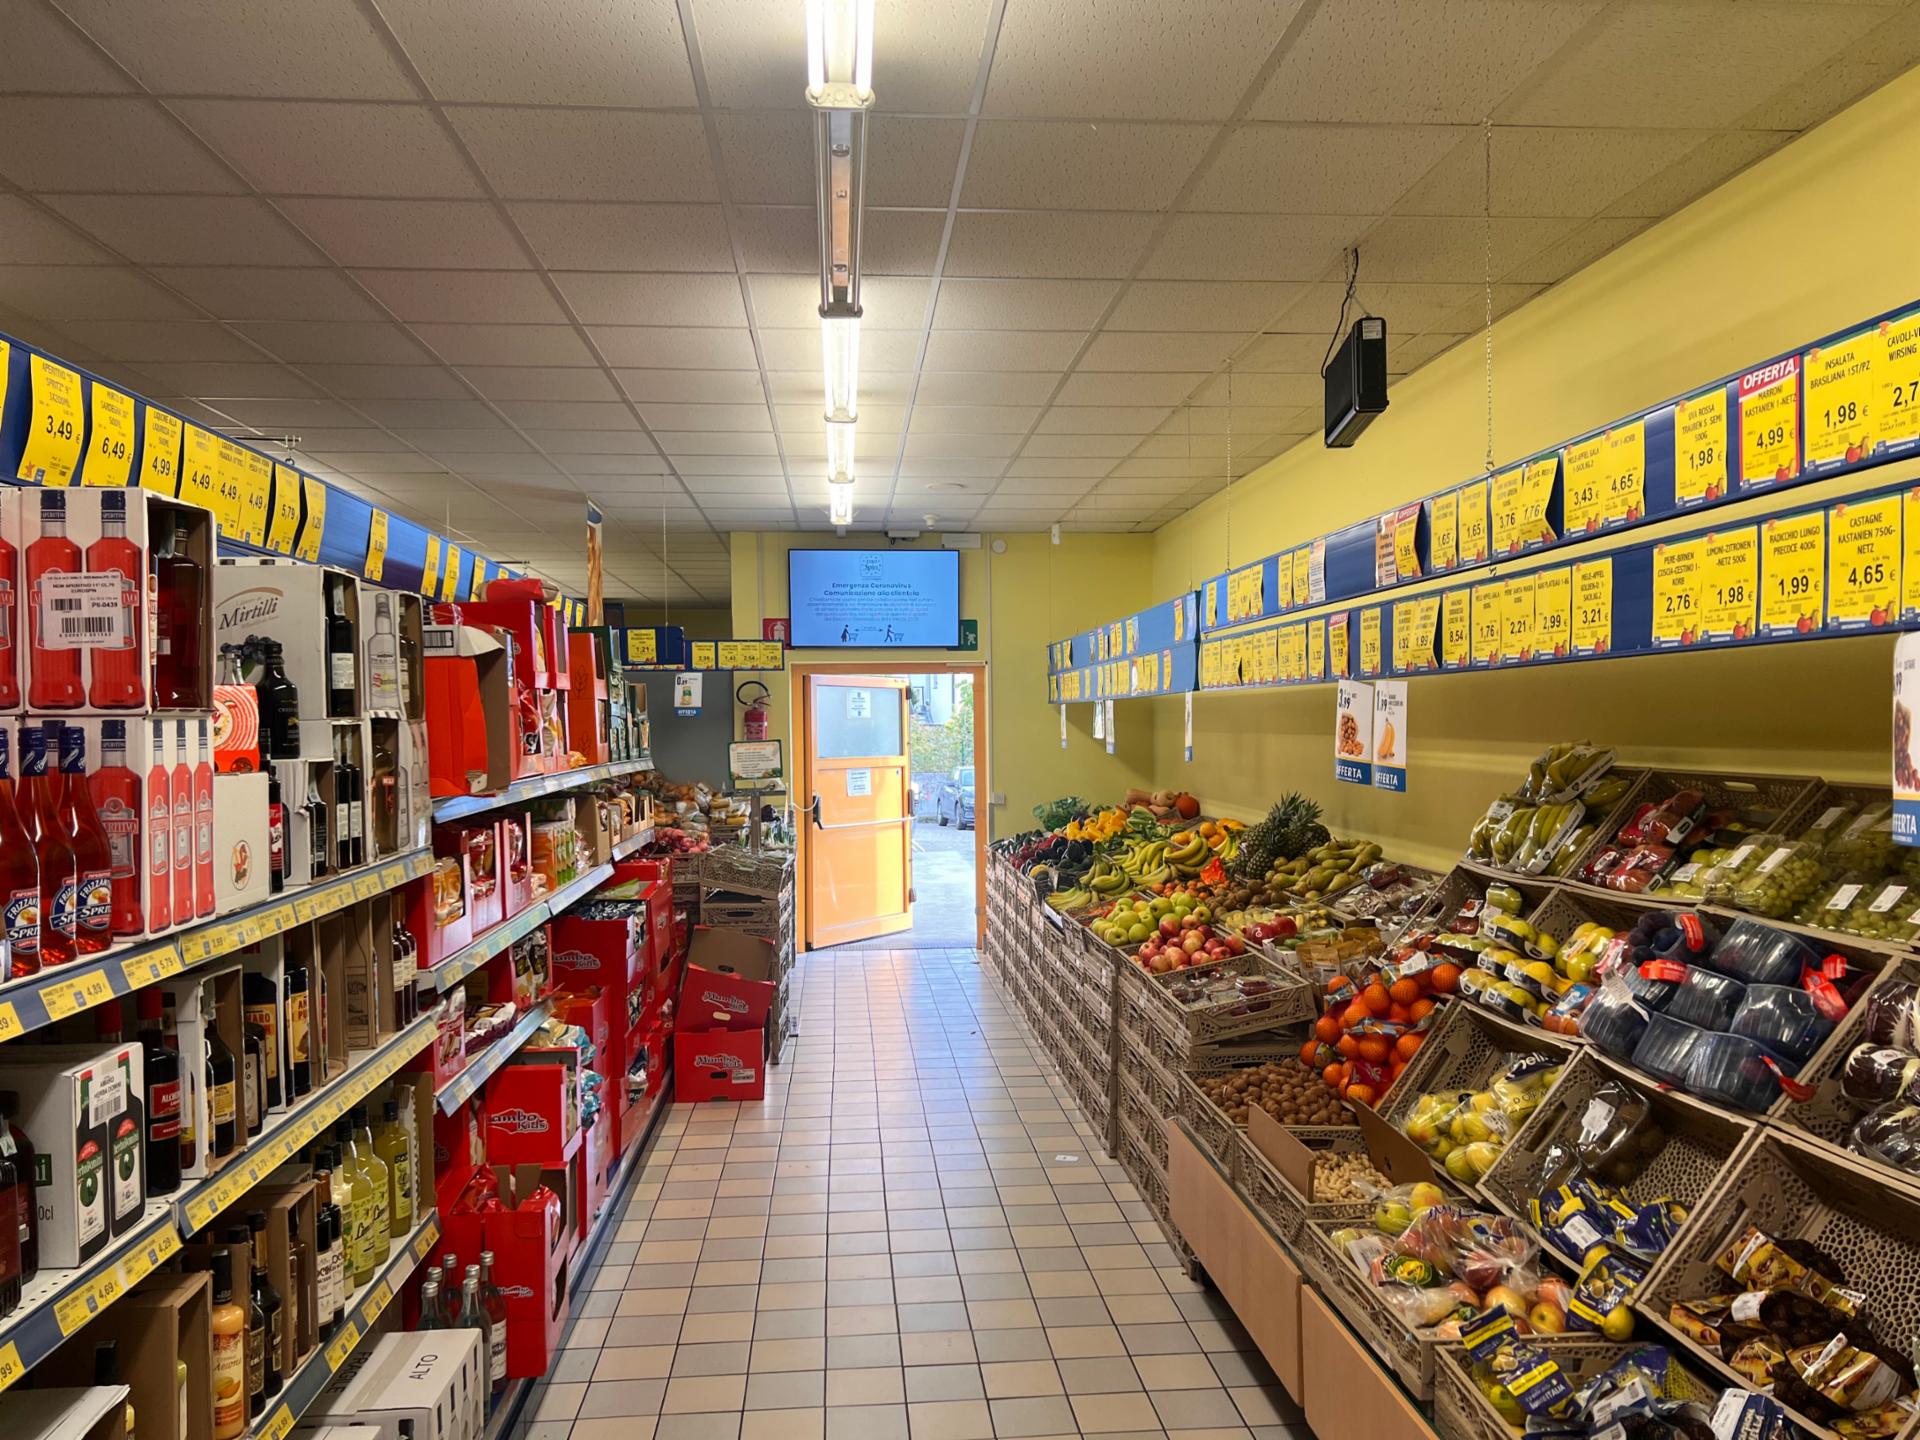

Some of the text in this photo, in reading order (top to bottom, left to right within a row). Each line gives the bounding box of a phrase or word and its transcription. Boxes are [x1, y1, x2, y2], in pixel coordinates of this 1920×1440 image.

[1825, 352, 1855, 370] INSALATA
[1889, 343, 1917, 362] WIRSING
[1743, 358, 1795, 389] OFFERTA
[1810, 371, 1846, 389] BRASILIANA
[1758, 385, 1783, 400] MARRONI
[1893, 380, 1920, 408] 2,7
[1745, 401, 1774, 418] KASTANIEN
[1824, 401, 1857, 429] 1,98
[46, 415, 73, 441] 3,49
[1756, 426, 1784, 450] 4,99
[102, 437, 125, 460] 6,49
[152, 455, 171, 476] 4,99
[1690, 447, 1713, 471] 1,98
[192, 470, 210, 490] 4,49
[1611, 473, 1633, 493] 4,65
[220, 481, 237, 500] 4,49
[1574, 487, 1593, 506] 3,43
[249, 492, 263, 510] 4,49
[281, 504, 295, 520] 5,79
[1500, 513, 1516, 529] 3,76
[1849, 512, 1883, 528] CASTAGNE
[1800, 526, 1820, 539] LUNGO
[1838, 529, 1873, 544] KASTANIEN
[1857, 543, 1874, 555] NETZ
[1848, 563, 1884, 589] 4,65
[832, 582, 869, 590] Emergenza
[1778, 575, 1809, 598] 1,99
[1666, 593, 1690, 613] 2,76
[1717, 586, 1744, 607] 1,98
[218, 597, 279, 631] Mirtilli
[1544, 614, 1561, 631] 2,99
[1582, 608, 1601, 625] 3,21
[1449, 630, 1464, 643] 8,54
[1480, 624, 1494, 639] 1,76
[1510, 620, 1526, 635] 2,21
[1892, 814, 1917, 835] FFERTA
[492, 1110, 540, 1121] ambo
[518, 1121, 547, 1130] Kids
[38, 1204, 54, 1221] 0cl
[326, 1351, 374, 1394] FRAGILE
[408, 1354, 439, 1380] ALTO
